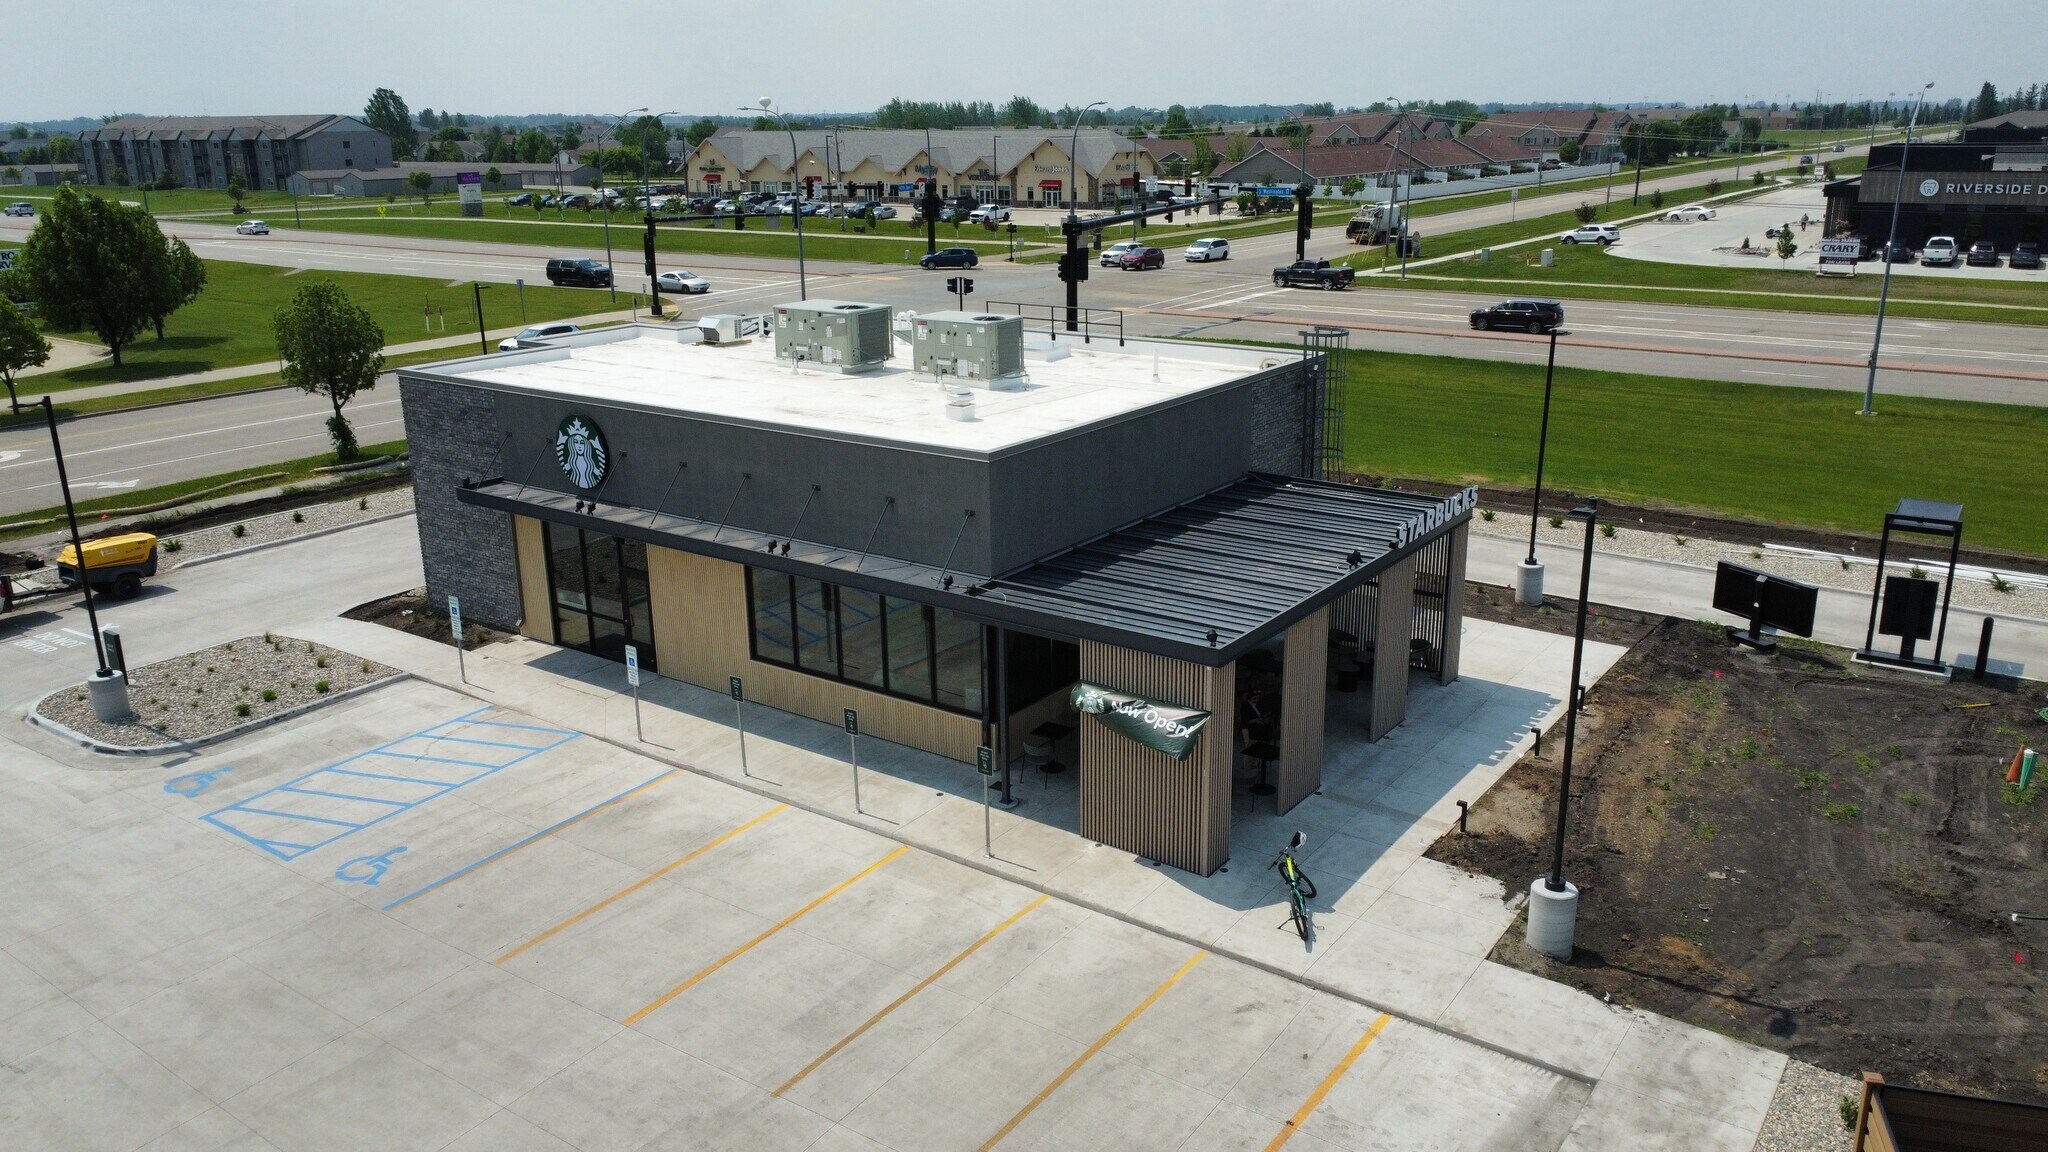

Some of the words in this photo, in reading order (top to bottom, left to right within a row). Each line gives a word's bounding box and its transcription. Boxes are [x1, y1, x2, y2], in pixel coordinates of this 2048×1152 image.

[1946, 183, 2032, 194] RIVERSIDE
[1822, 244, 1857, 253] CRARY
[1397, 485, 1479, 549] STARBUCKS
[13, 639, 58, 654] ENTER
[1144, 709, 1194, 738] Open!
